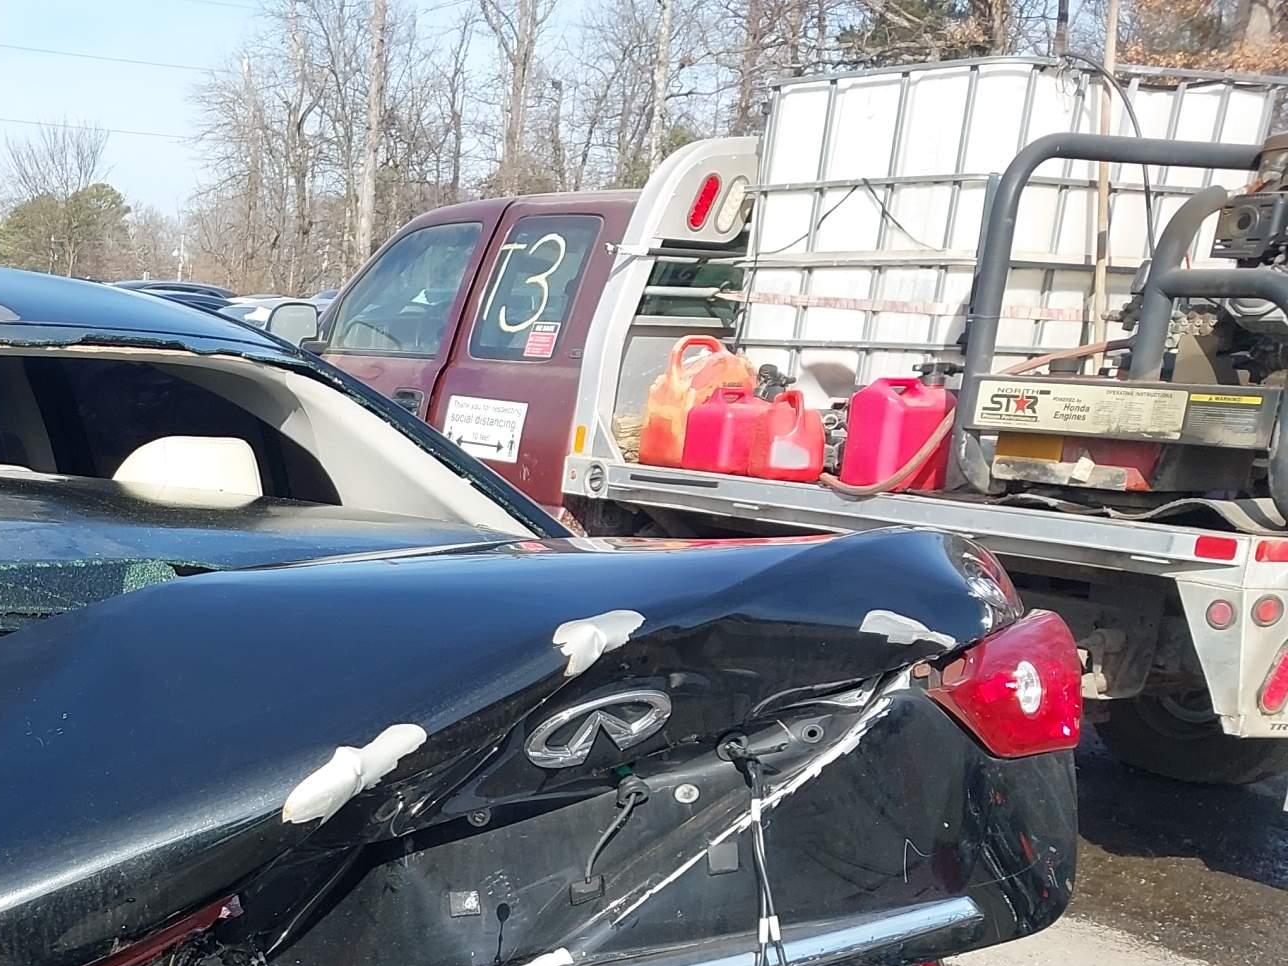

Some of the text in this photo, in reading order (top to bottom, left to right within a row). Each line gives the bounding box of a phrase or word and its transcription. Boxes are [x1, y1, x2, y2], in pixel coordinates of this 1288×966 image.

[482, 233, 566, 332] T3
[997, 387, 1039, 395] NORTH
[1063, 403, 1090, 412] Honda
[1053, 411, 1086, 421] Engines
[450, 413, 517, 432] social distancing
